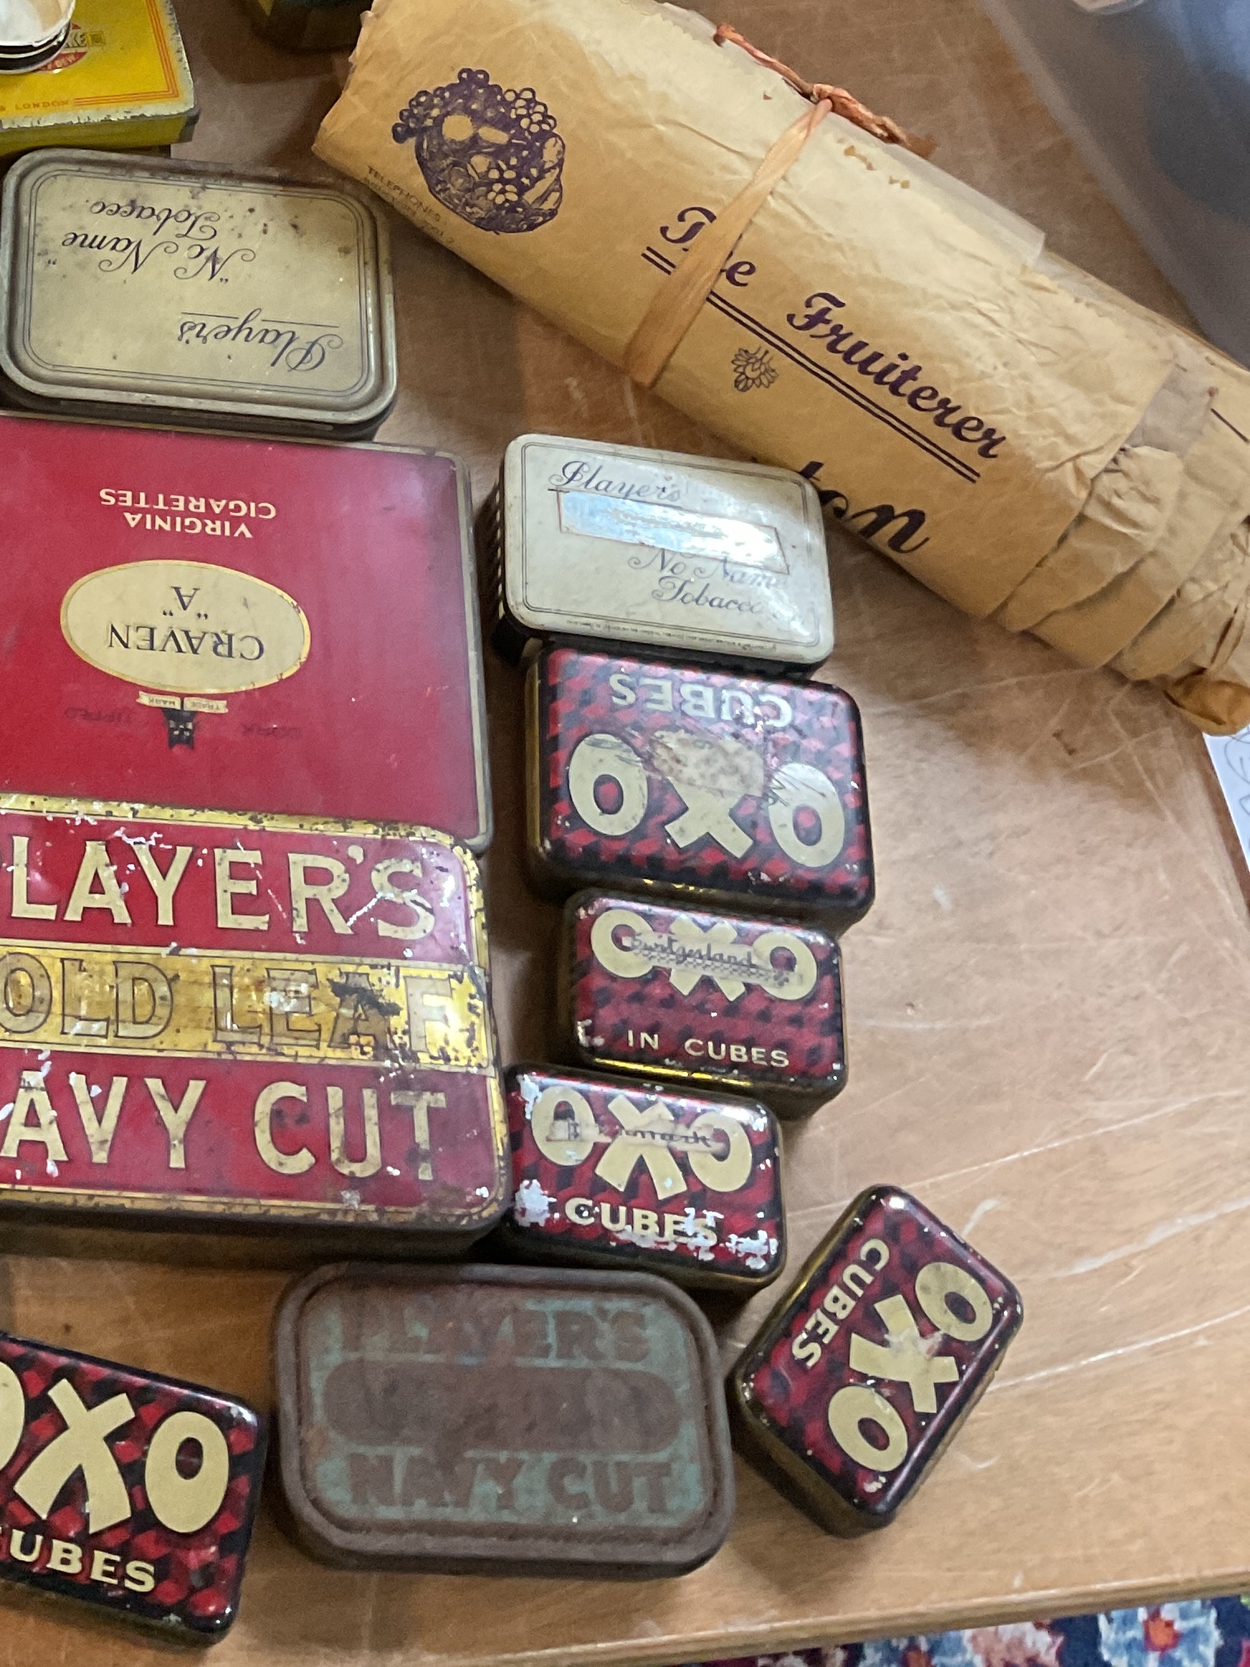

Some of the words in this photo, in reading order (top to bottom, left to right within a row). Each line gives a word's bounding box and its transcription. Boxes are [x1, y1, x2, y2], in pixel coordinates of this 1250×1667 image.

[15, 99, 69, 111] LONDON
[660, 205, 756, 289] Te
[787, 291, 1007, 459] Fruiterer
[100, 488, 277, 519] CIGARETTES
[127, 511, 253, 539] VIRGINIA
[106, 623, 266, 661] CRAVEN
[609, 673, 793, 728] CUBES
[211, 963, 455, 1053] LEAF
[627, 1030, 659, 1050] IN
[684, 1038, 790, 1068] CUBES
[253, 1080, 447, 1180] CUT
[531, 1086, 752, 1200] OXO
[565, 1197, 718, 1246] CUBES
[791, 1239, 890, 1369] CUBES
[828, 1261, 993, 1472] OXO
[552, 1459, 673, 1514] CUT
